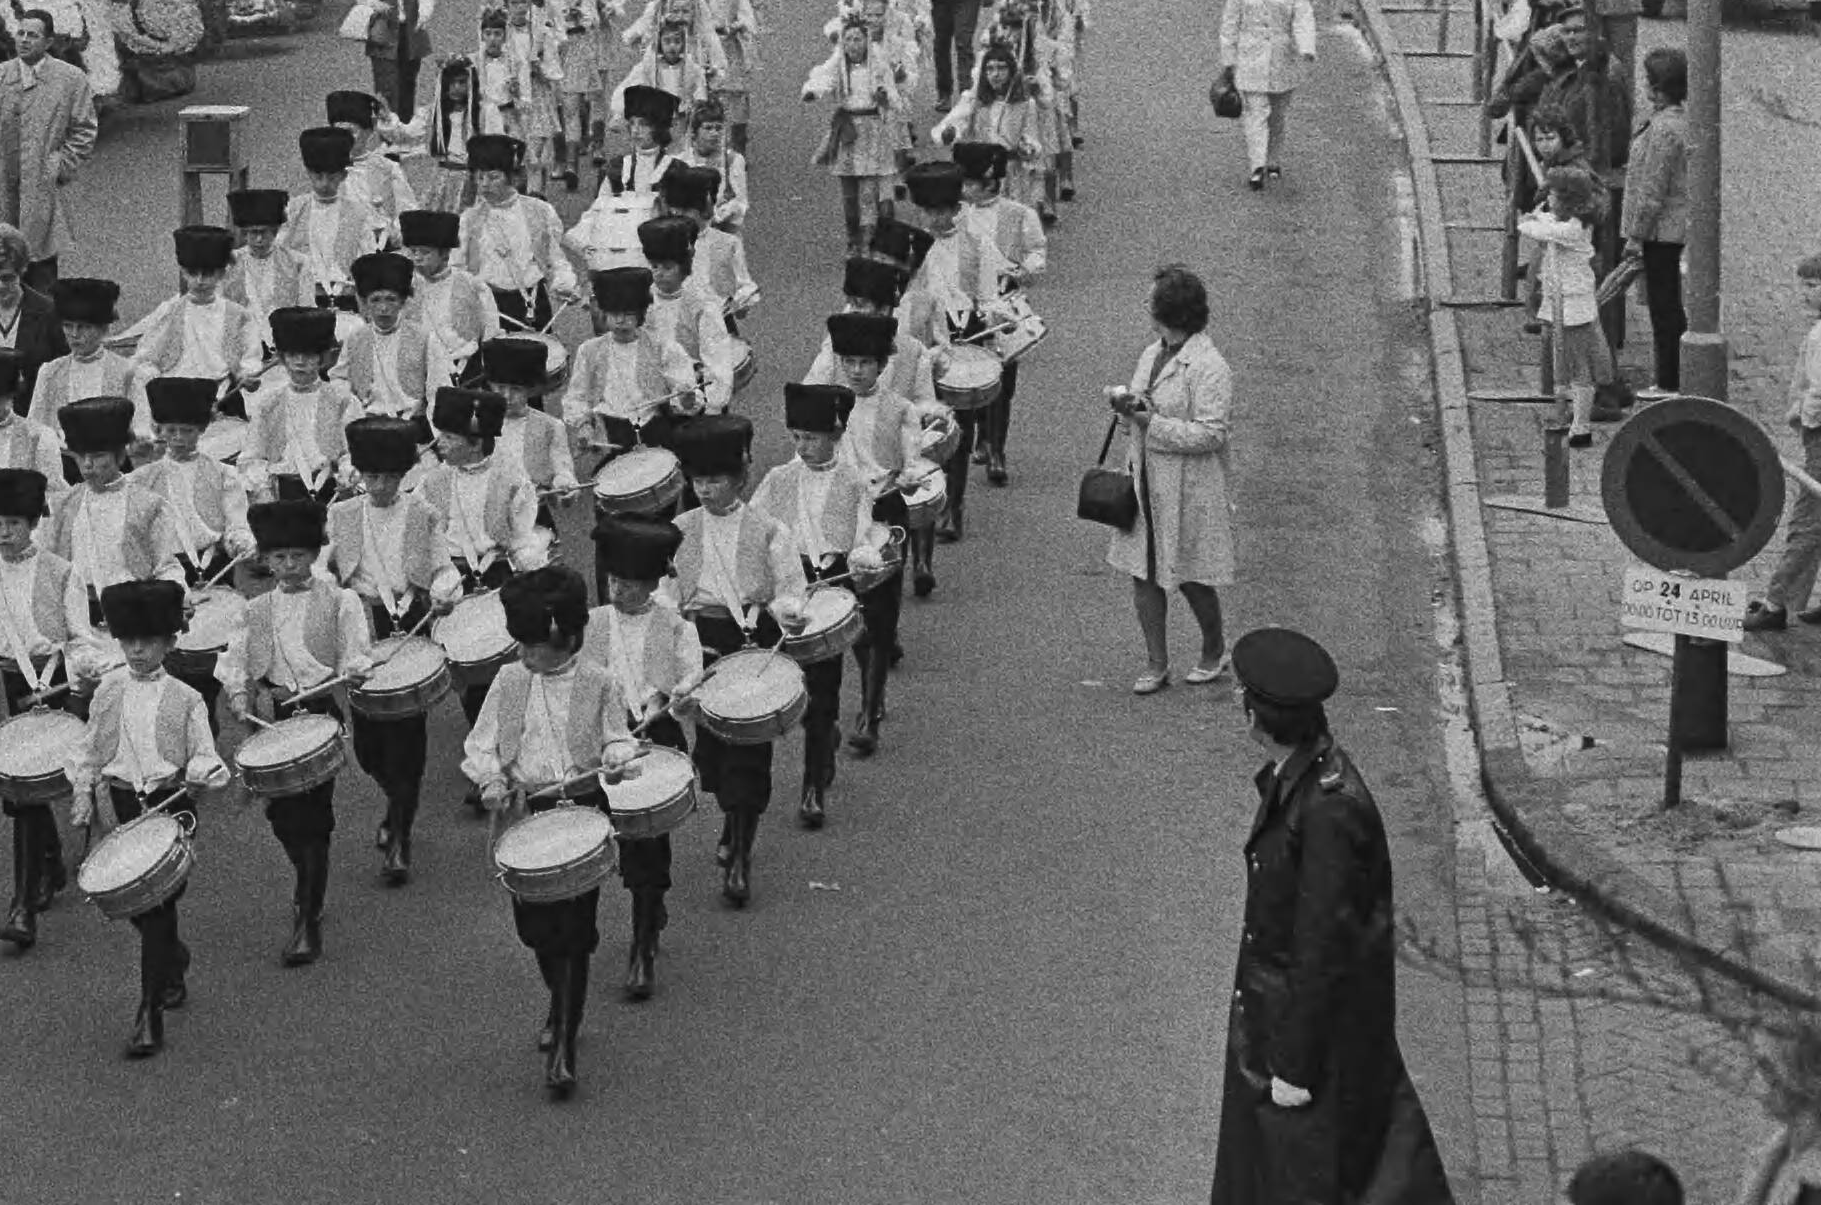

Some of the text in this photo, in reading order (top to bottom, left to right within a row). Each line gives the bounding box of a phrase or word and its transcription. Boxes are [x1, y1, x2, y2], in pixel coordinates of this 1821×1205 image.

[1632, 579, 1735, 607] OP 24 APRIL
[1656, 606, 1682, 623] TOT
